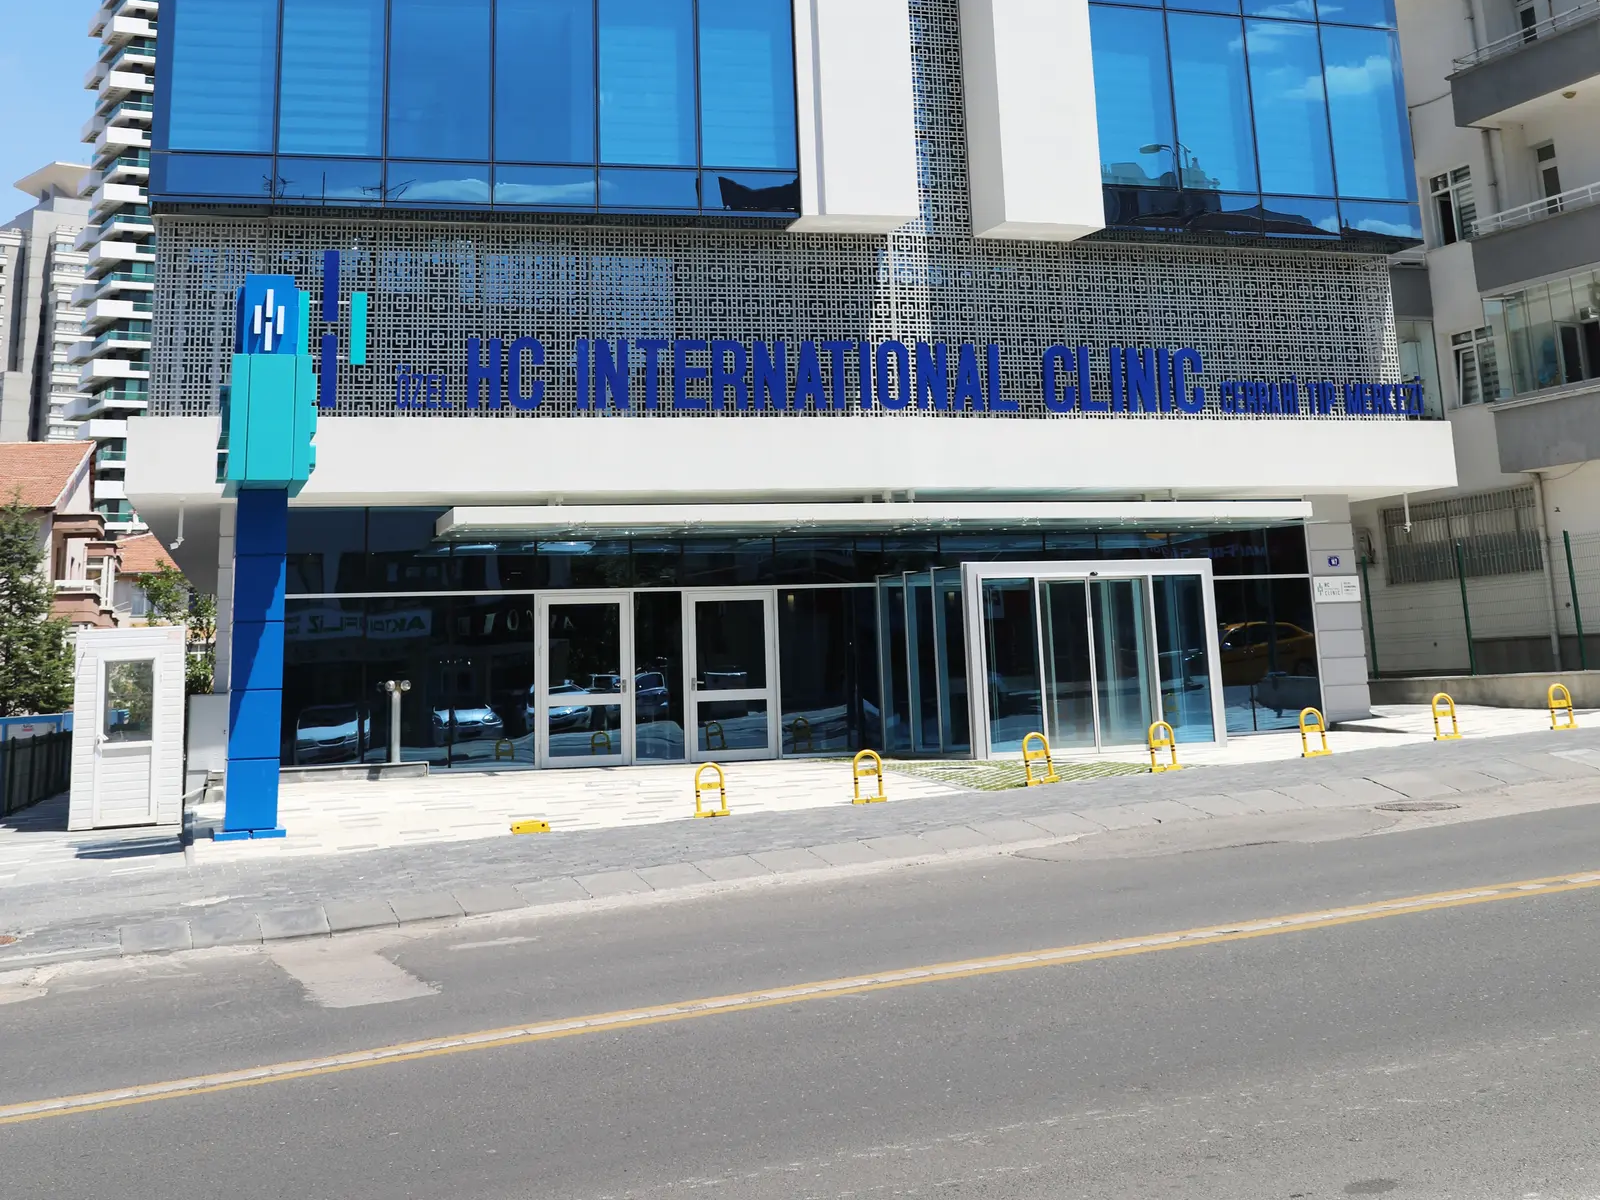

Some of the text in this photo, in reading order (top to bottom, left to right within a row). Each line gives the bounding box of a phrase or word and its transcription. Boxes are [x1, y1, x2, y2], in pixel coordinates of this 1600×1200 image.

[396, 364, 452, 409] ÖZEL
[466, 336, 545, 410] HC
[574, 338, 1019, 411] INTERNATIONAL
[1042, 344, 1206, 414] CLINIC
[1304, 380, 1337, 416] TIP
[1343, 375, 1425, 416] MERKEZİ
